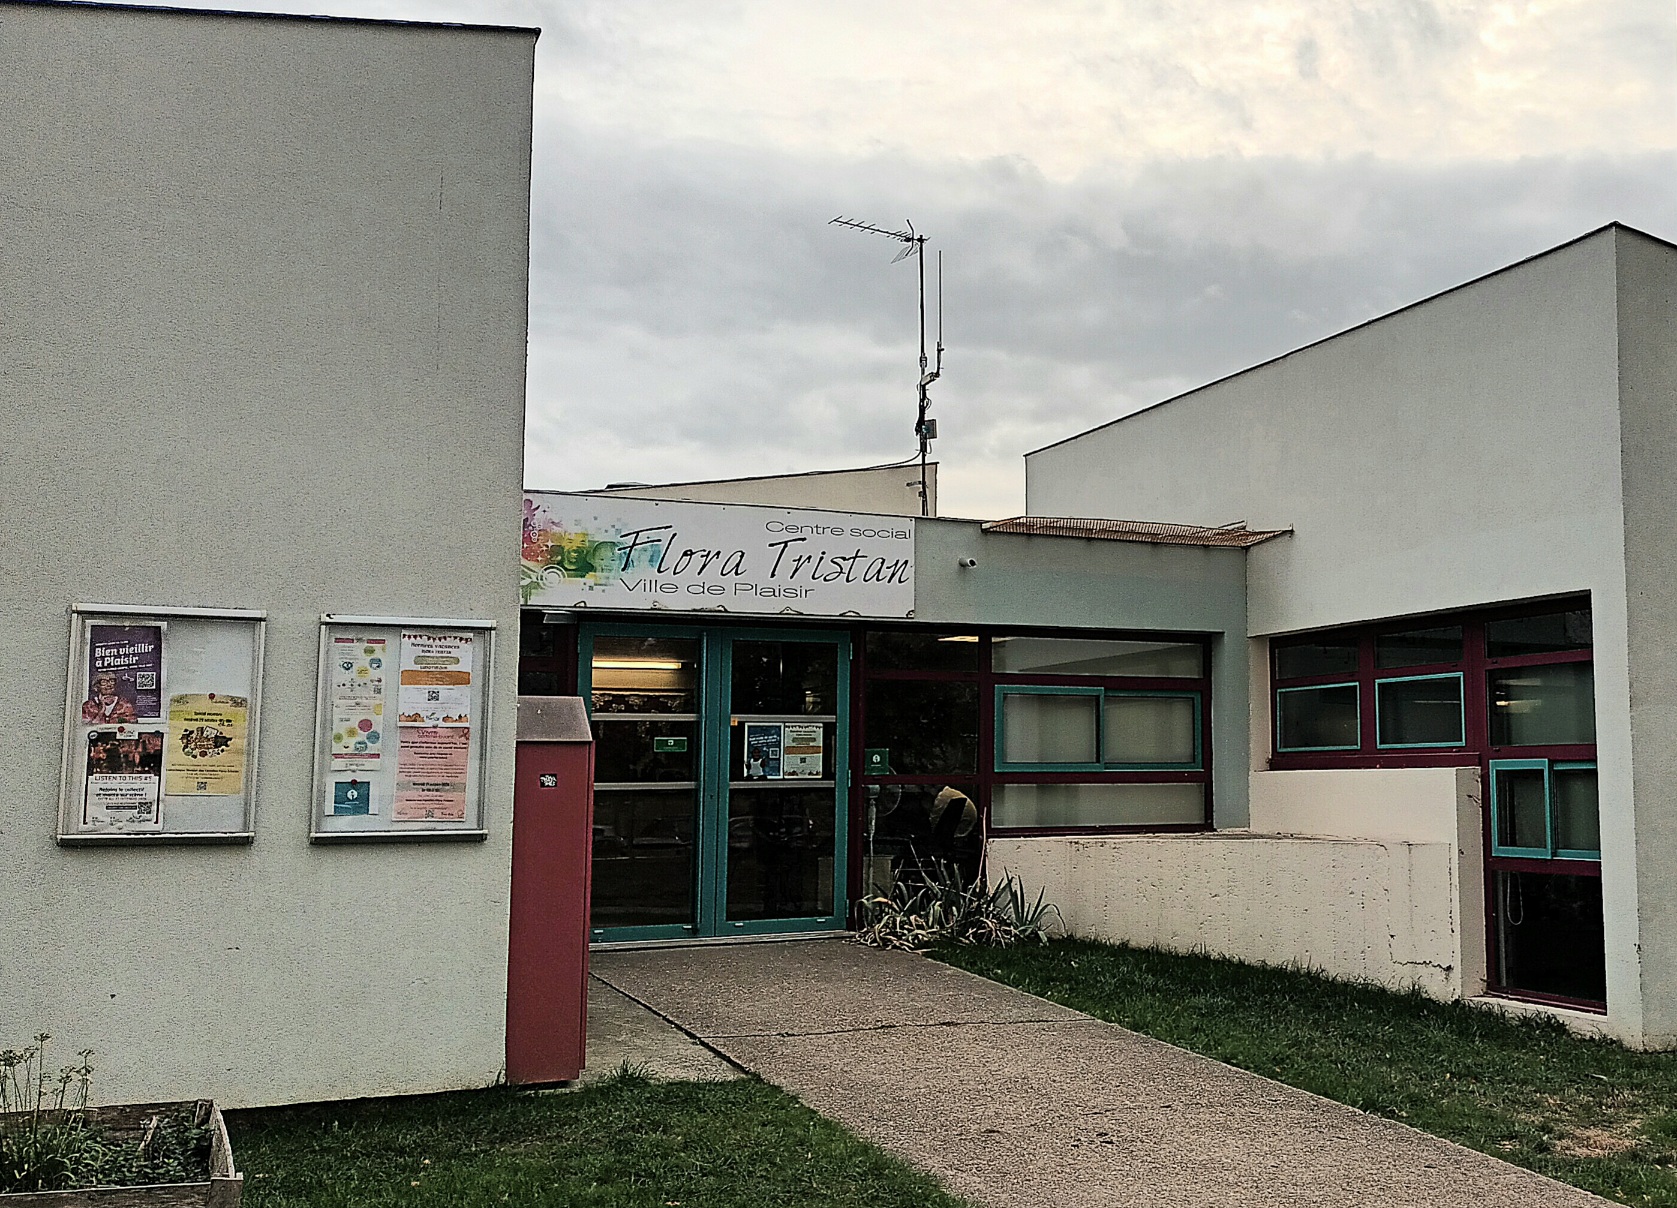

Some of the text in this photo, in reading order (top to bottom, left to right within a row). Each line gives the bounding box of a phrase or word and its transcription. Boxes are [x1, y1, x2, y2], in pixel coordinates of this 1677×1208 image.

[765, 520, 911, 540] Centre social
[617, 525, 910, 585] Flora Tristan
[619, 577, 815, 599] Ville de Plaisir
[95, 647, 117, 657] Bien
[119, 643, 154, 655] vieillir
[95, 655, 139, 667] à Plaisir
